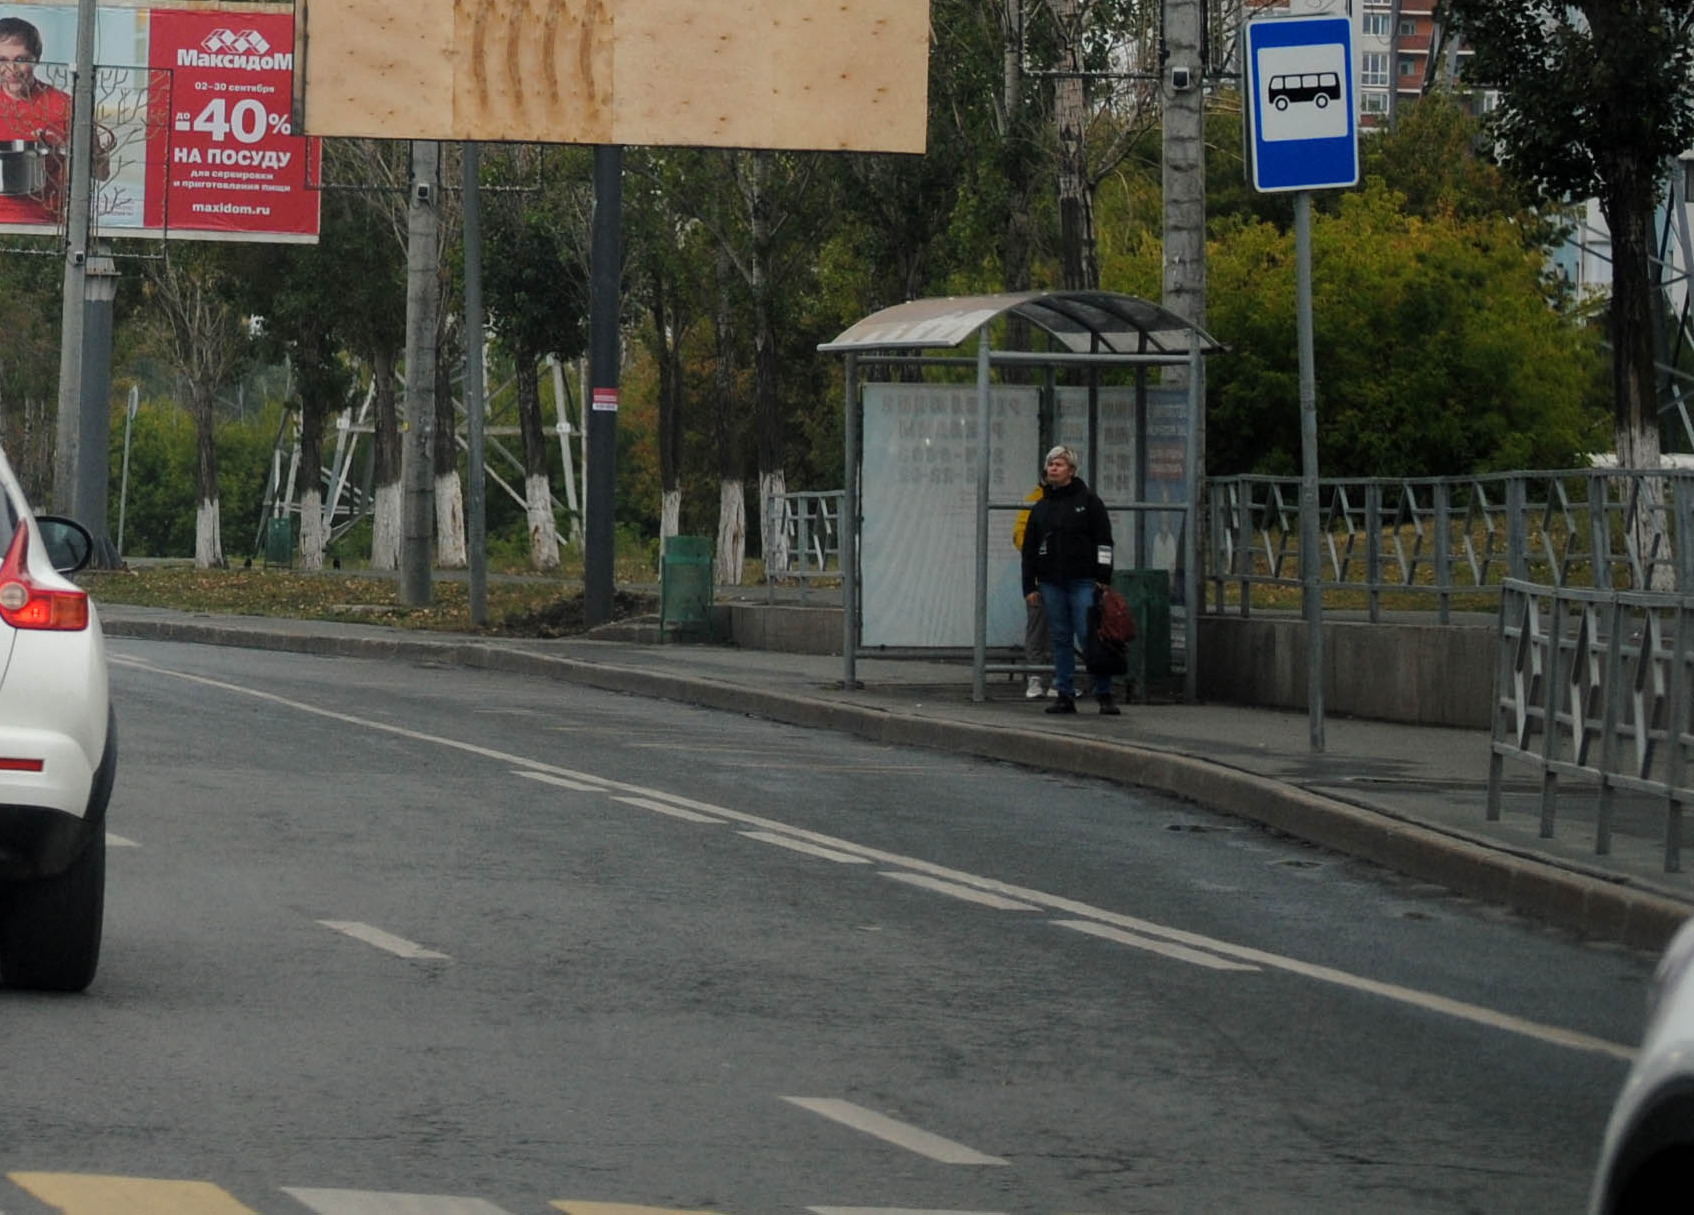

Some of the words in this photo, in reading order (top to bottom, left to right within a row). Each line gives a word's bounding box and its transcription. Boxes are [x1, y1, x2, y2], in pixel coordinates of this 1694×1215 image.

[228, 84, 275, 94] сентября
[176, 112, 190, 121] до
[174, 147, 203, 164] НА
[207, 149, 292, 170] ПОСУДУ
[191, 169, 210, 178] для
[212, 171, 274, 181] сервировки
[192, 202, 271, 215] maxidom.ru
